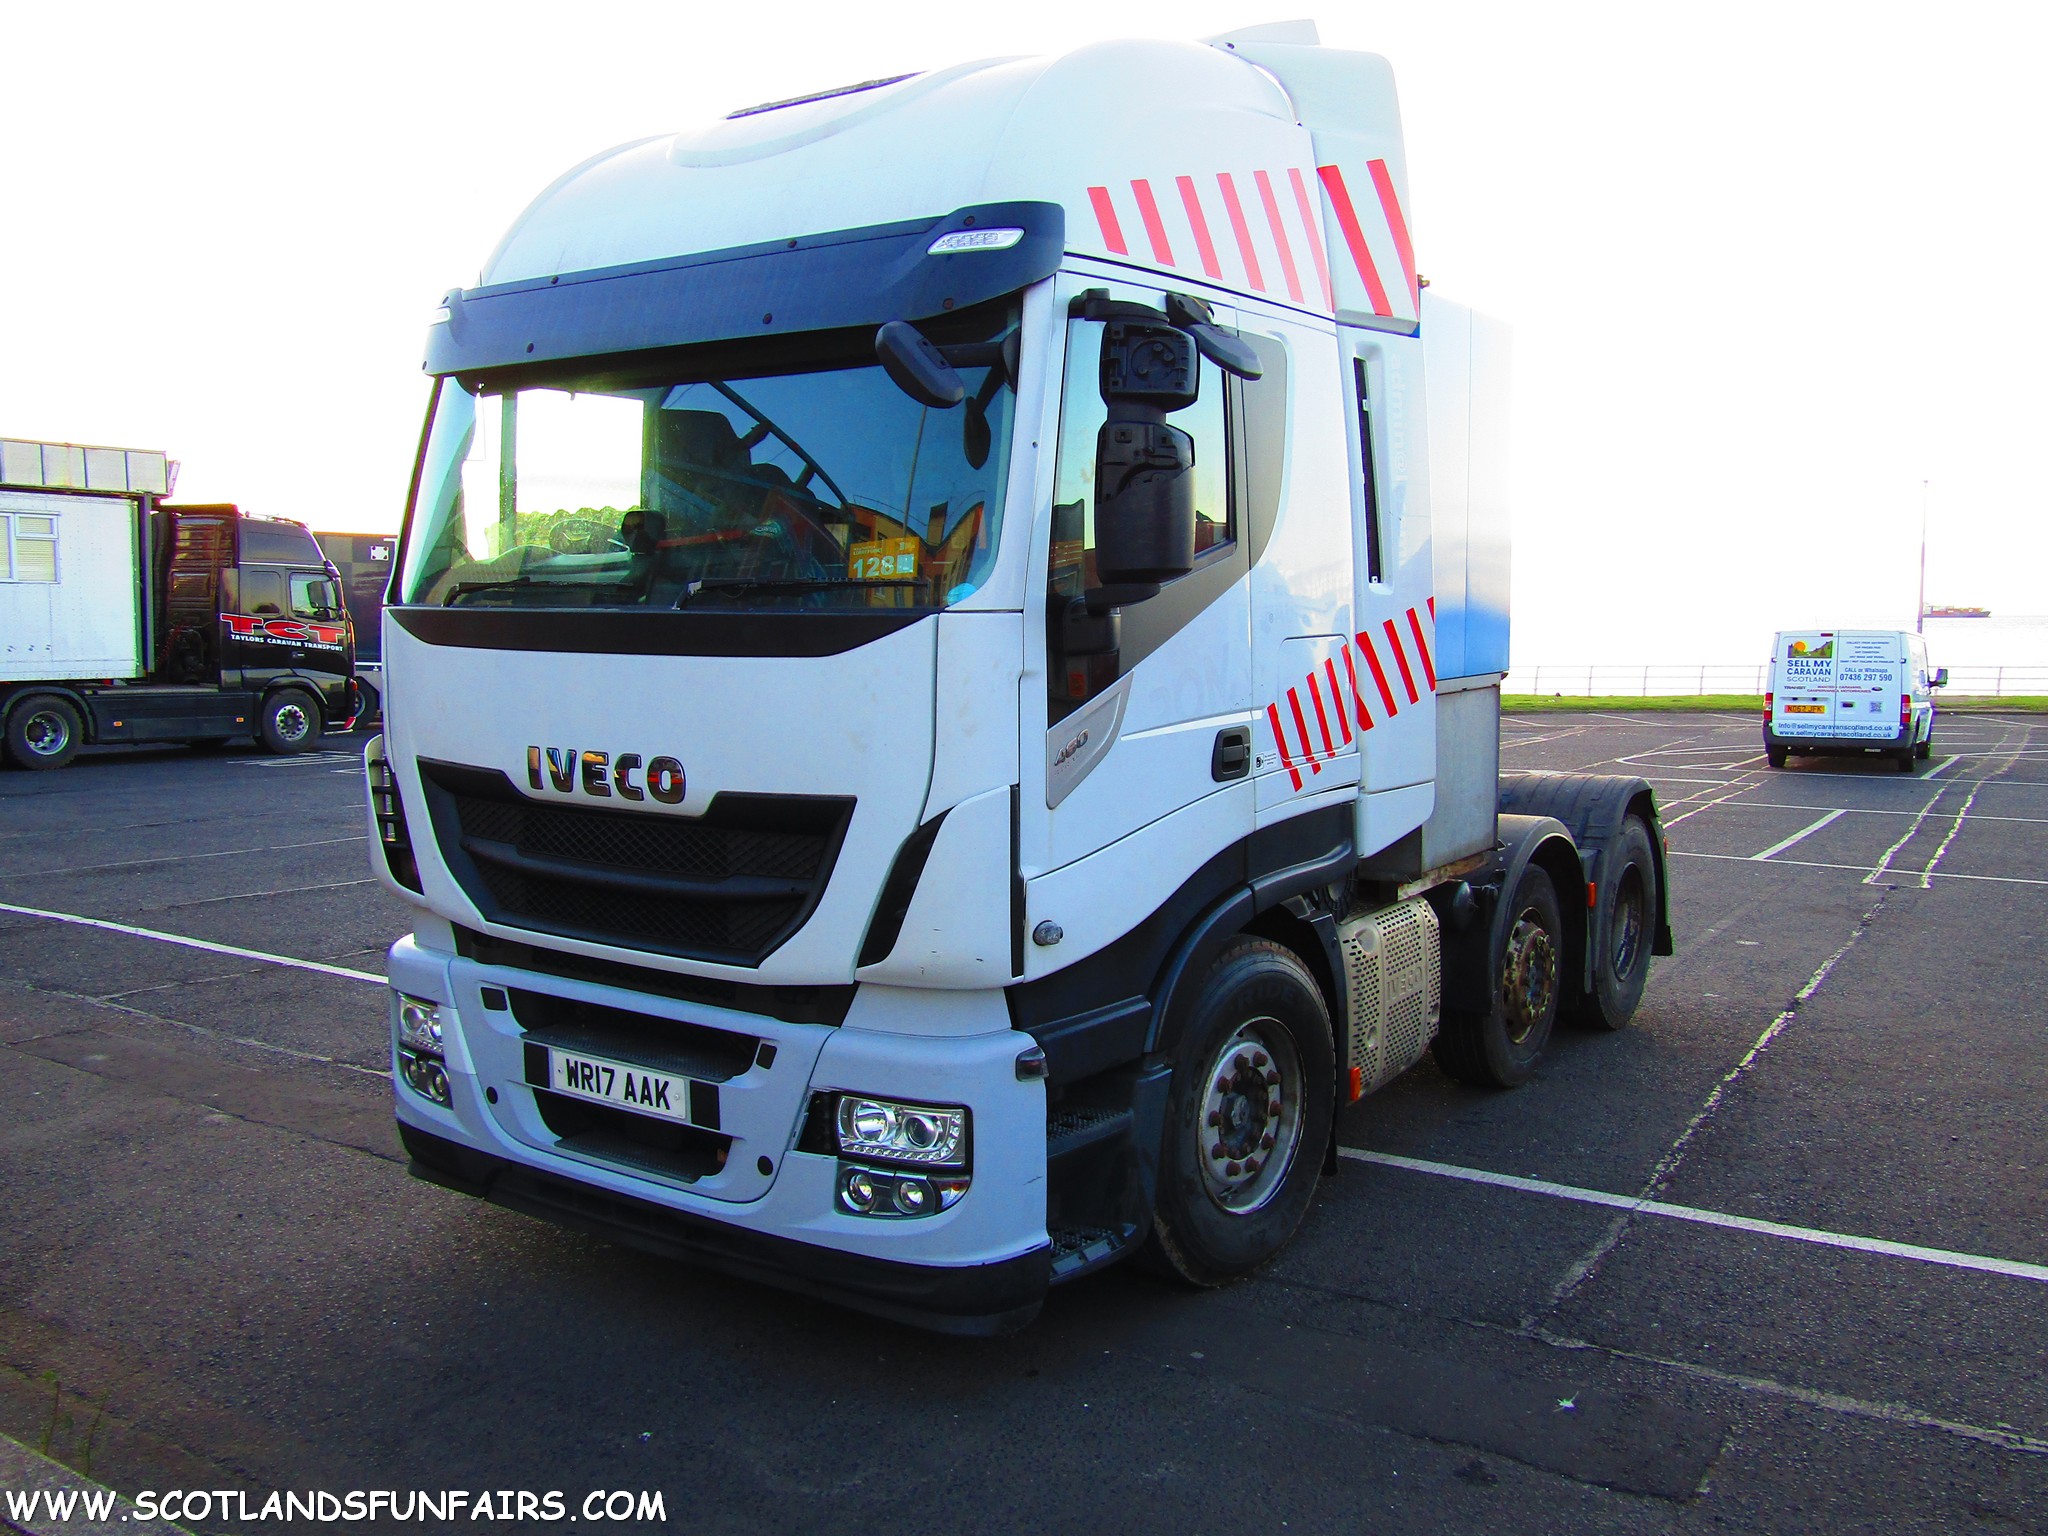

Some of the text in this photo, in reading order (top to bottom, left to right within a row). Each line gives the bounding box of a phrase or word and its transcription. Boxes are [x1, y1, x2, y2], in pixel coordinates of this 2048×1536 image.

[853, 555, 895, 579] 128
[220, 612, 346, 645] TCT
[231, 633, 343, 652] TAYLORS CARAVAN TRANSPORT
[527, 745, 687, 804] IVECO
[1386, 967, 1424, 1001] IVECO
[565, 1057, 671, 1111] WR17 AAK
